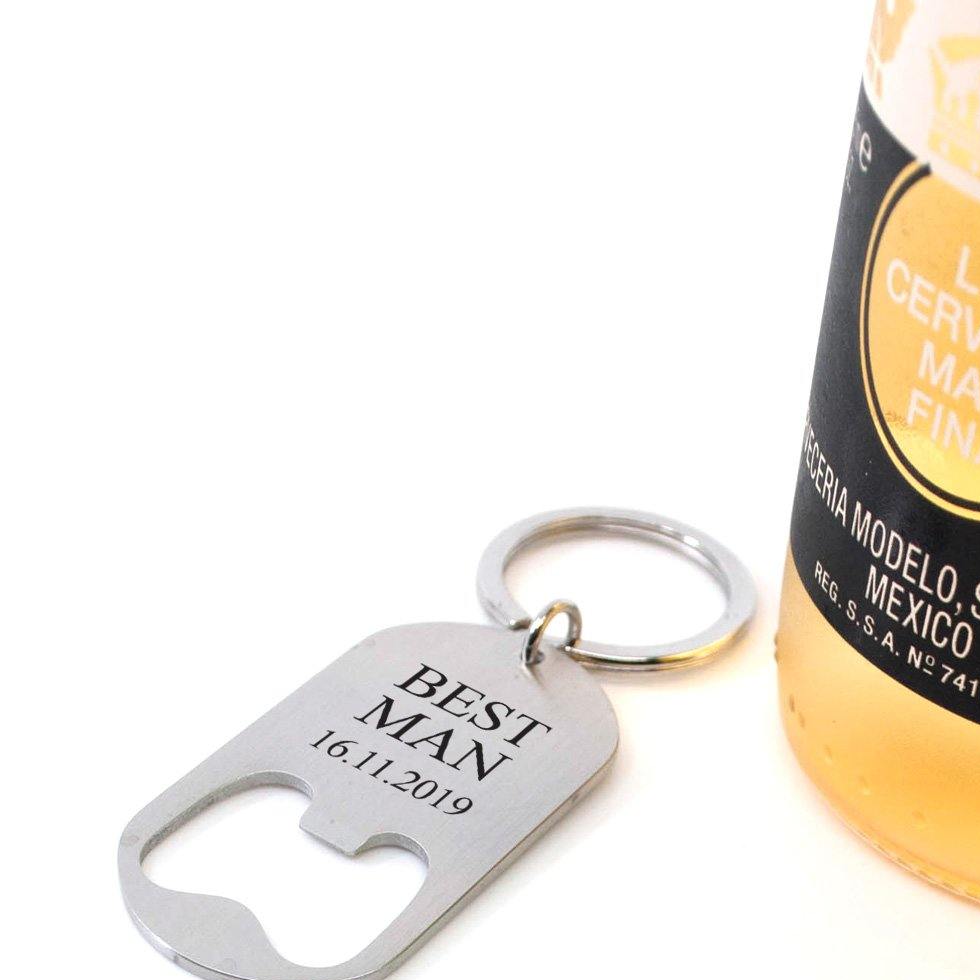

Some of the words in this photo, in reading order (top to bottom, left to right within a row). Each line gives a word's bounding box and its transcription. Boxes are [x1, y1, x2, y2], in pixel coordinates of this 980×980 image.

[814, 560, 842, 608] REG.
[851, 501, 962, 616] MODELO,
[865, 564, 973, 659] MEXICO
[353, 694, 513, 782] MAN
[393, 663, 552, 748] BEST
[308, 729, 474, 815] 16.11.2019
